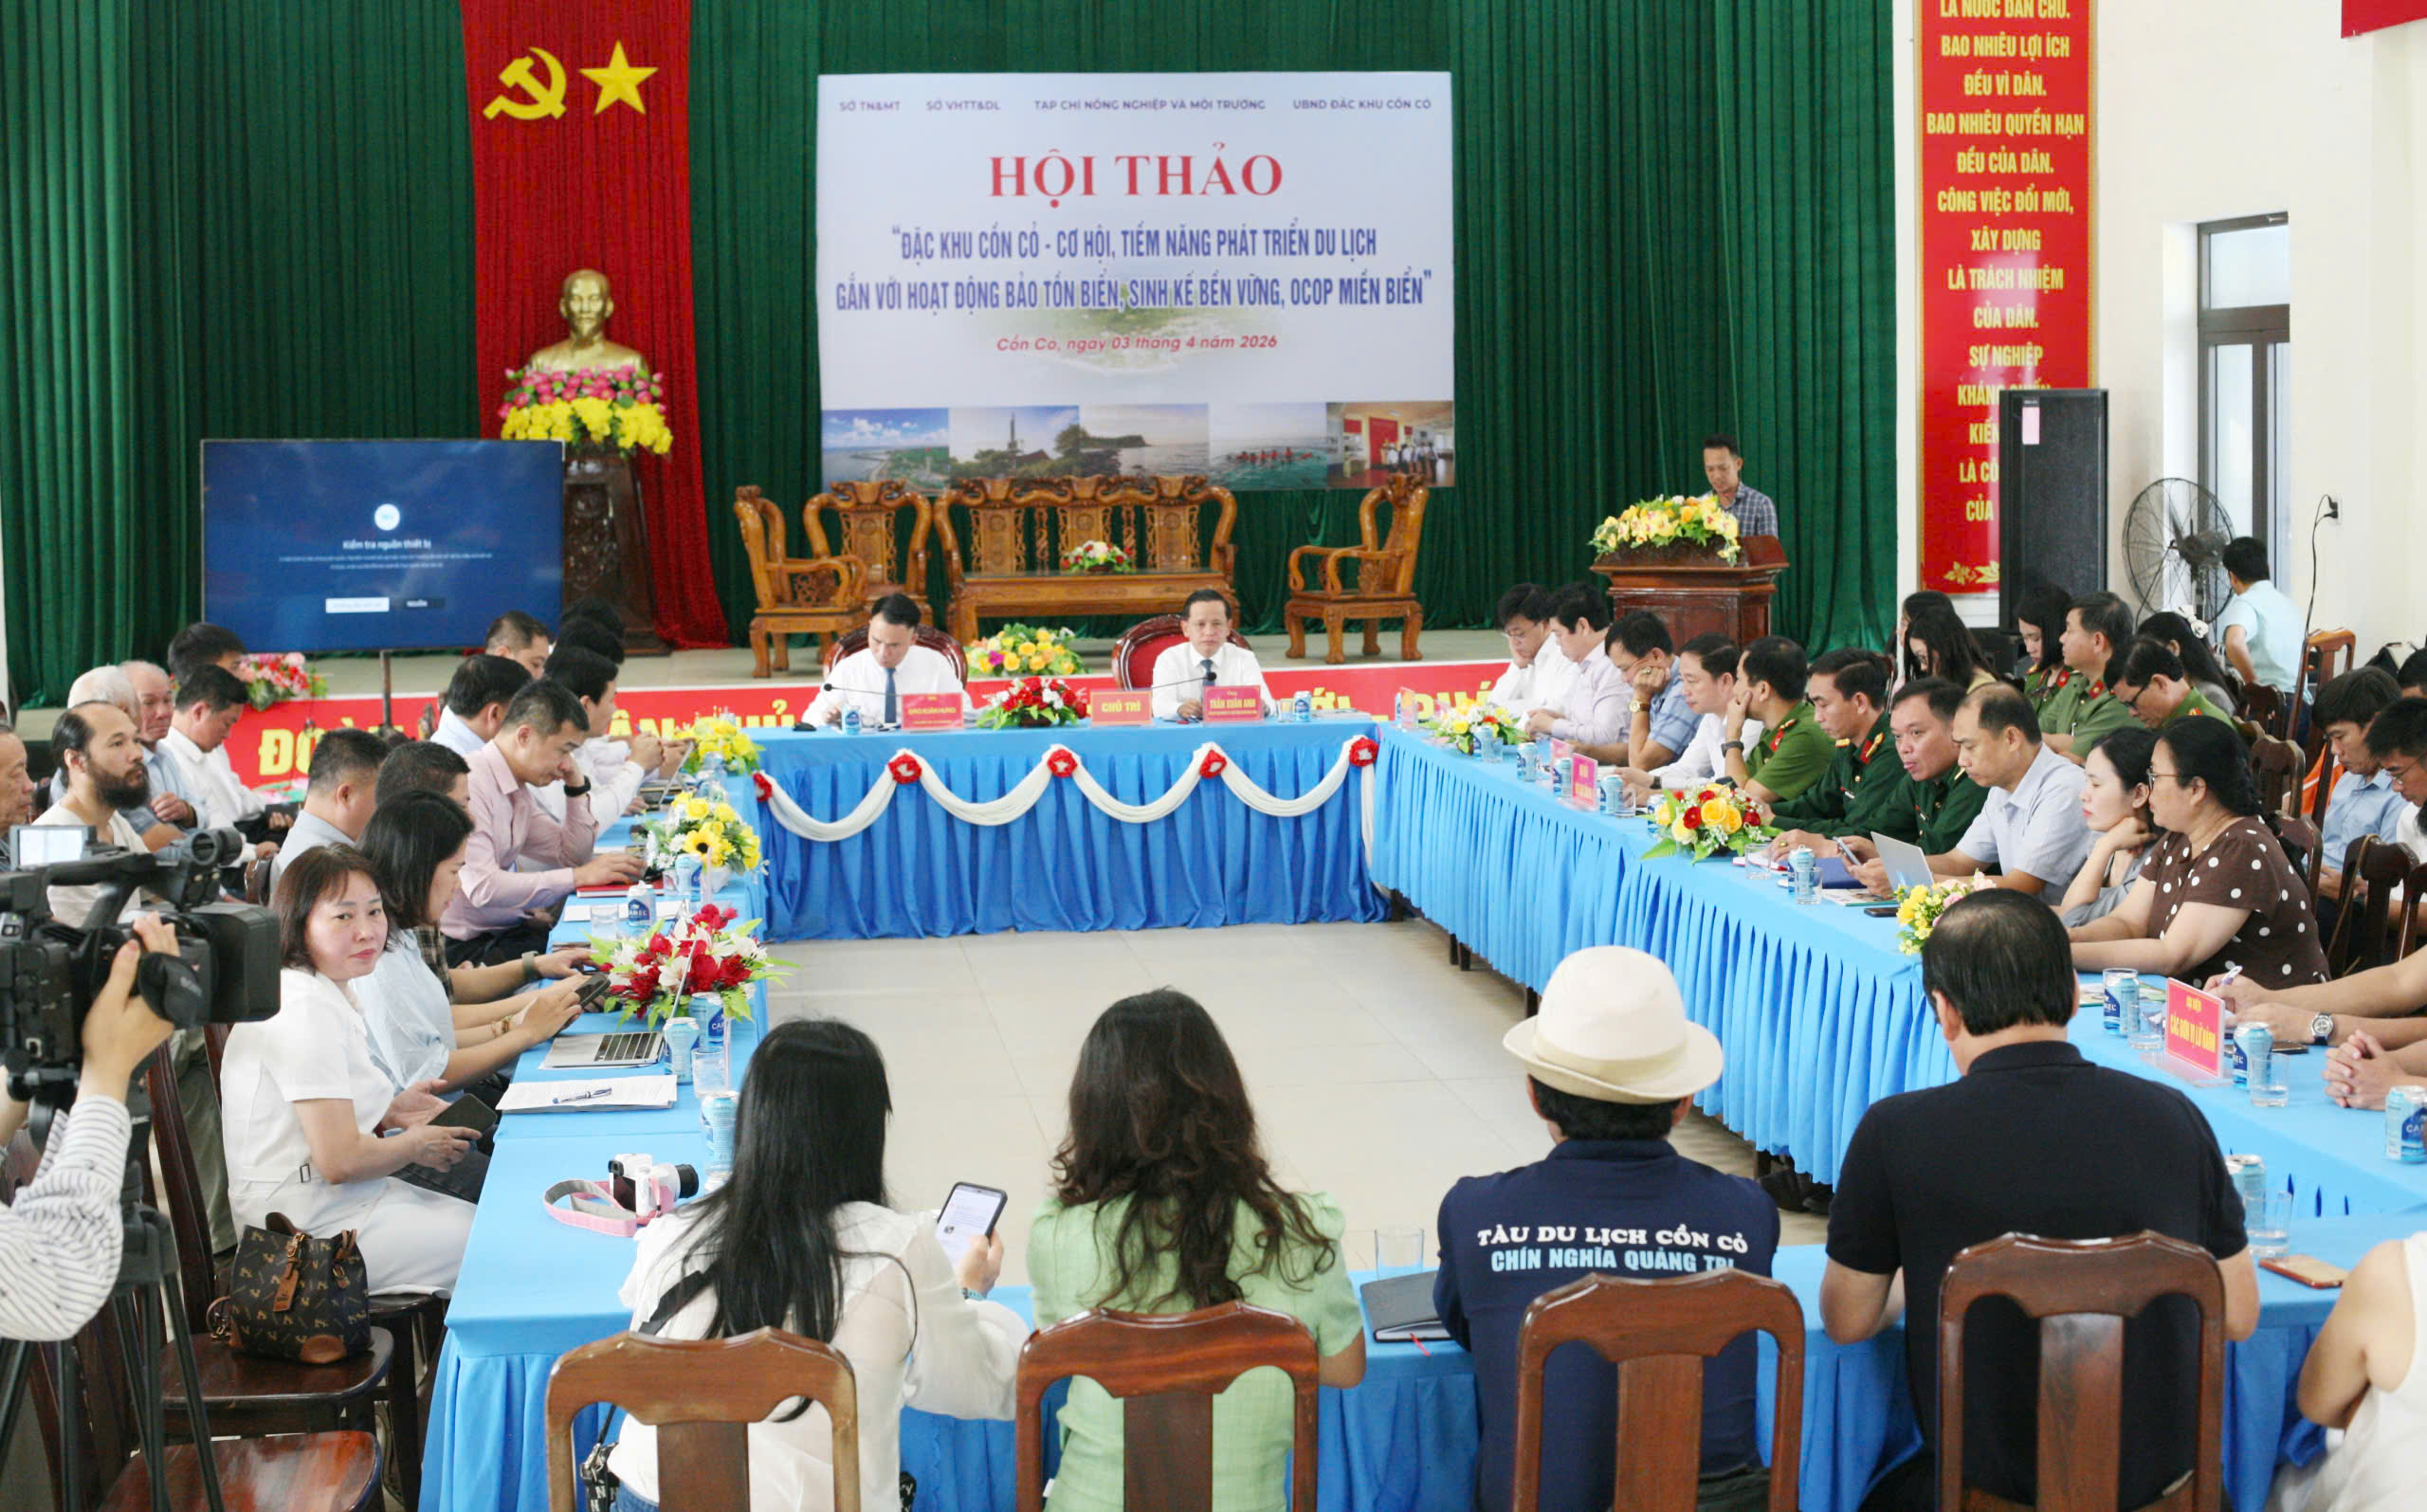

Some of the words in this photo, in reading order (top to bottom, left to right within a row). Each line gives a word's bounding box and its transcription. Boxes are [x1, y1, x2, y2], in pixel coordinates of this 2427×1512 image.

[1941, 35, 1970, 57] BAO
[1973, 31, 2016, 57] NHIÊU
[2019, 34, 2042, 62] LỢI
[2046, 31, 2071, 58] ÍCH
[1963, 68, 1993, 96] ĐỀU
[1995, 70, 2010, 96] VÌ
[2013, 70, 2047, 96] DÂN.
[1292, 99, 1327, 110] UBND
[1359, 99, 1383, 110] KHU
[1926, 112, 1955, 135] BAO
[1959, 109, 2001, 135] NHIÊU
[2005, 107, 2052, 137] QUYỀN
[2055, 113, 2085, 140] HẠN
[1957, 145, 1985, 173] ĐỀU
[1988, 145, 2017, 173] CỦA
[2020, 148, 2054, 173] DÂN.
[988, 148, 1098, 209] HỘI
[1115, 141, 1283, 196] THẢO
[1937, 186, 1977, 212] CÔNG
[1980, 186, 2012, 217] VIỆC
[2015, 183, 2038, 212] ĐỔI
[940, 230, 973, 259] KHU
[1018, 220, 1040, 259] CỎ
[1056, 228, 1078, 258] CƠ
[1084, 224, 1116, 264] HỘI,
[1165, 223, 1212, 257] NĂNG
[1216, 223, 1258, 257] PHÁT
[1263, 216, 1310, 257] TRIỂN
[1314, 228, 1336, 256] DU
[1341, 228, 1378, 263] LỊCH
[1971, 225, 1999, 251] XÂY
[2002, 228, 2041, 256] DỰNG
[835, 271, 870, 311] GẮN
[875, 276, 902, 310] VỚI
[907, 281, 950, 317] HOẠT
[955, 275, 1000, 316] ĐỘNG
[1005, 270, 1038, 308] BẢO
[1128, 278, 1168, 307] SINH
[1174, 269, 1194, 306] KẾ
[1290, 278, 1334, 305] OCOP
[1947, 264, 1966, 290] LÀ
[1969, 264, 2015, 290] TRÁCH
[2017, 264, 2064, 294] NHIỆM
[1973, 304, 2002, 329] CỦA
[2005, 305, 2039, 329] DÂN.
[1111, 337, 1130, 350] 03
[1135, 335, 1181, 353] tháng
[1185, 336, 1195, 348] 4
[1200, 335, 1235, 348] năm
[1240, 335, 1278, 348] 2026
[1969, 343, 1991, 372] SỰ
[1992, 342, 2044, 372] NGHIỆP
[1959, 457, 1977, 483] LÀ
[1965, 493, 1995, 522] CỦA
[1477, 1223, 1529, 1247] TÀU
[1537, 1226, 1578, 1243] DU
[1584, 1227, 1648, 1248] LỊCH
[1655, 1223, 1710, 1248] CỒN
[1716, 1231, 1749, 1254] CỎ
[1490, 1245, 1542, 1272] CHÍN
[1548, 1246, 1617, 1269] NGHĨA
[1624, 1246, 1698, 1273] QUẢNG
